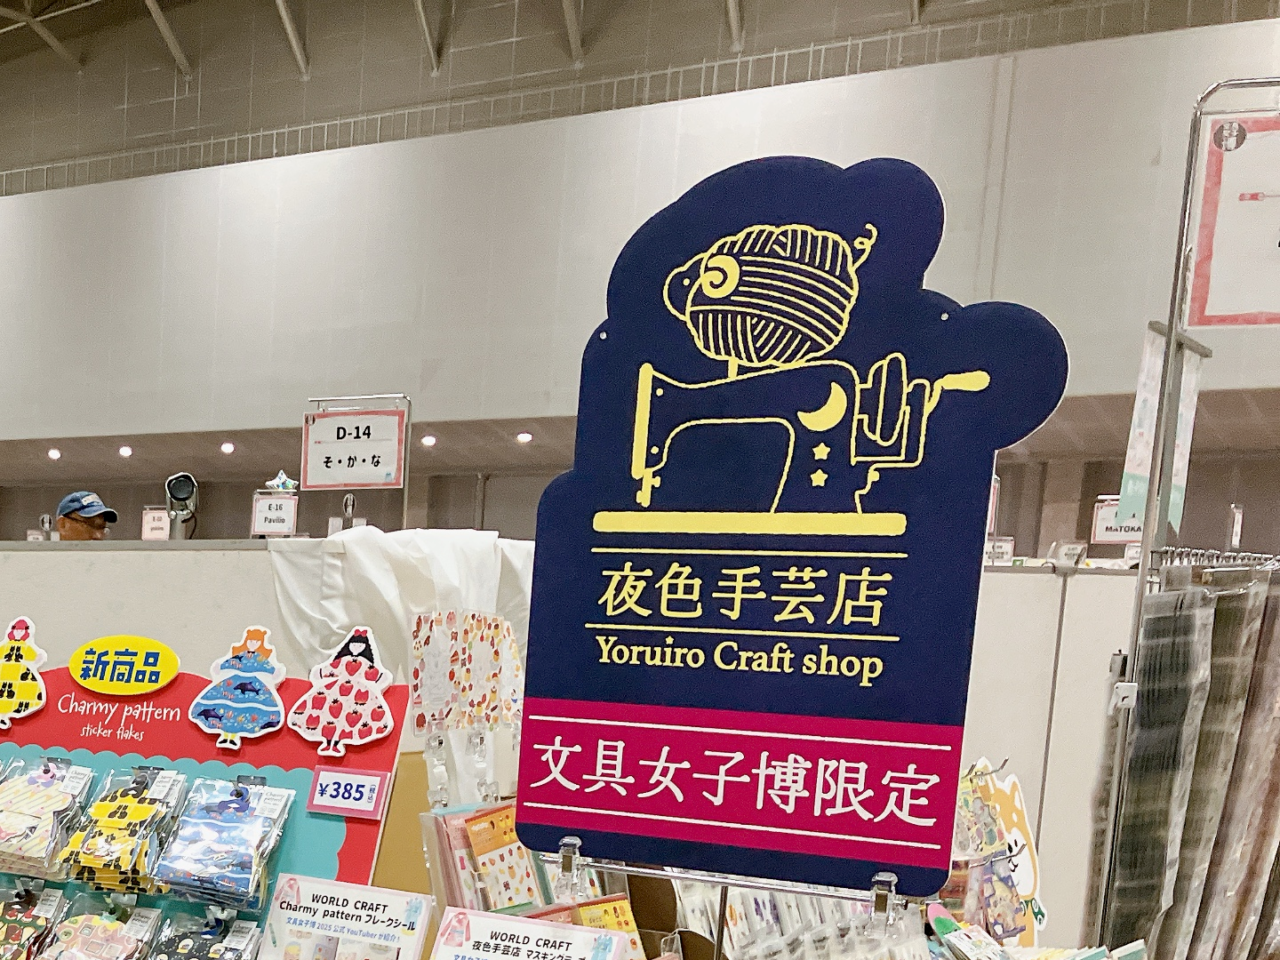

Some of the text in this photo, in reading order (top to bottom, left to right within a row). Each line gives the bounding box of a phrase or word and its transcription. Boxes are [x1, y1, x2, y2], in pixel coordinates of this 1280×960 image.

[336, 425, 372, 440] D-14
[323, 454, 381, 469] そ・か・な
[597, 560, 893, 627] 夜色手芸店
[81, 647, 161, 685] 新商品
[596, 635, 884, 687] Yoruiro Craft shop
[58, 692, 181, 725] Charmy pattern
[80, 723, 145, 742] sticker flakes
[318, 781, 366, 802] ¥385
[529, 735, 942, 827] 文具女子博限定
[279, 900, 319, 917] Charmy
[322, 909, 362, 923] pattern
[311, 893, 389, 914] WORLD CRAFT
[472, 940, 522, 957] 夜色手芸店
[490, 930, 573, 951] WORLD CRAFT
